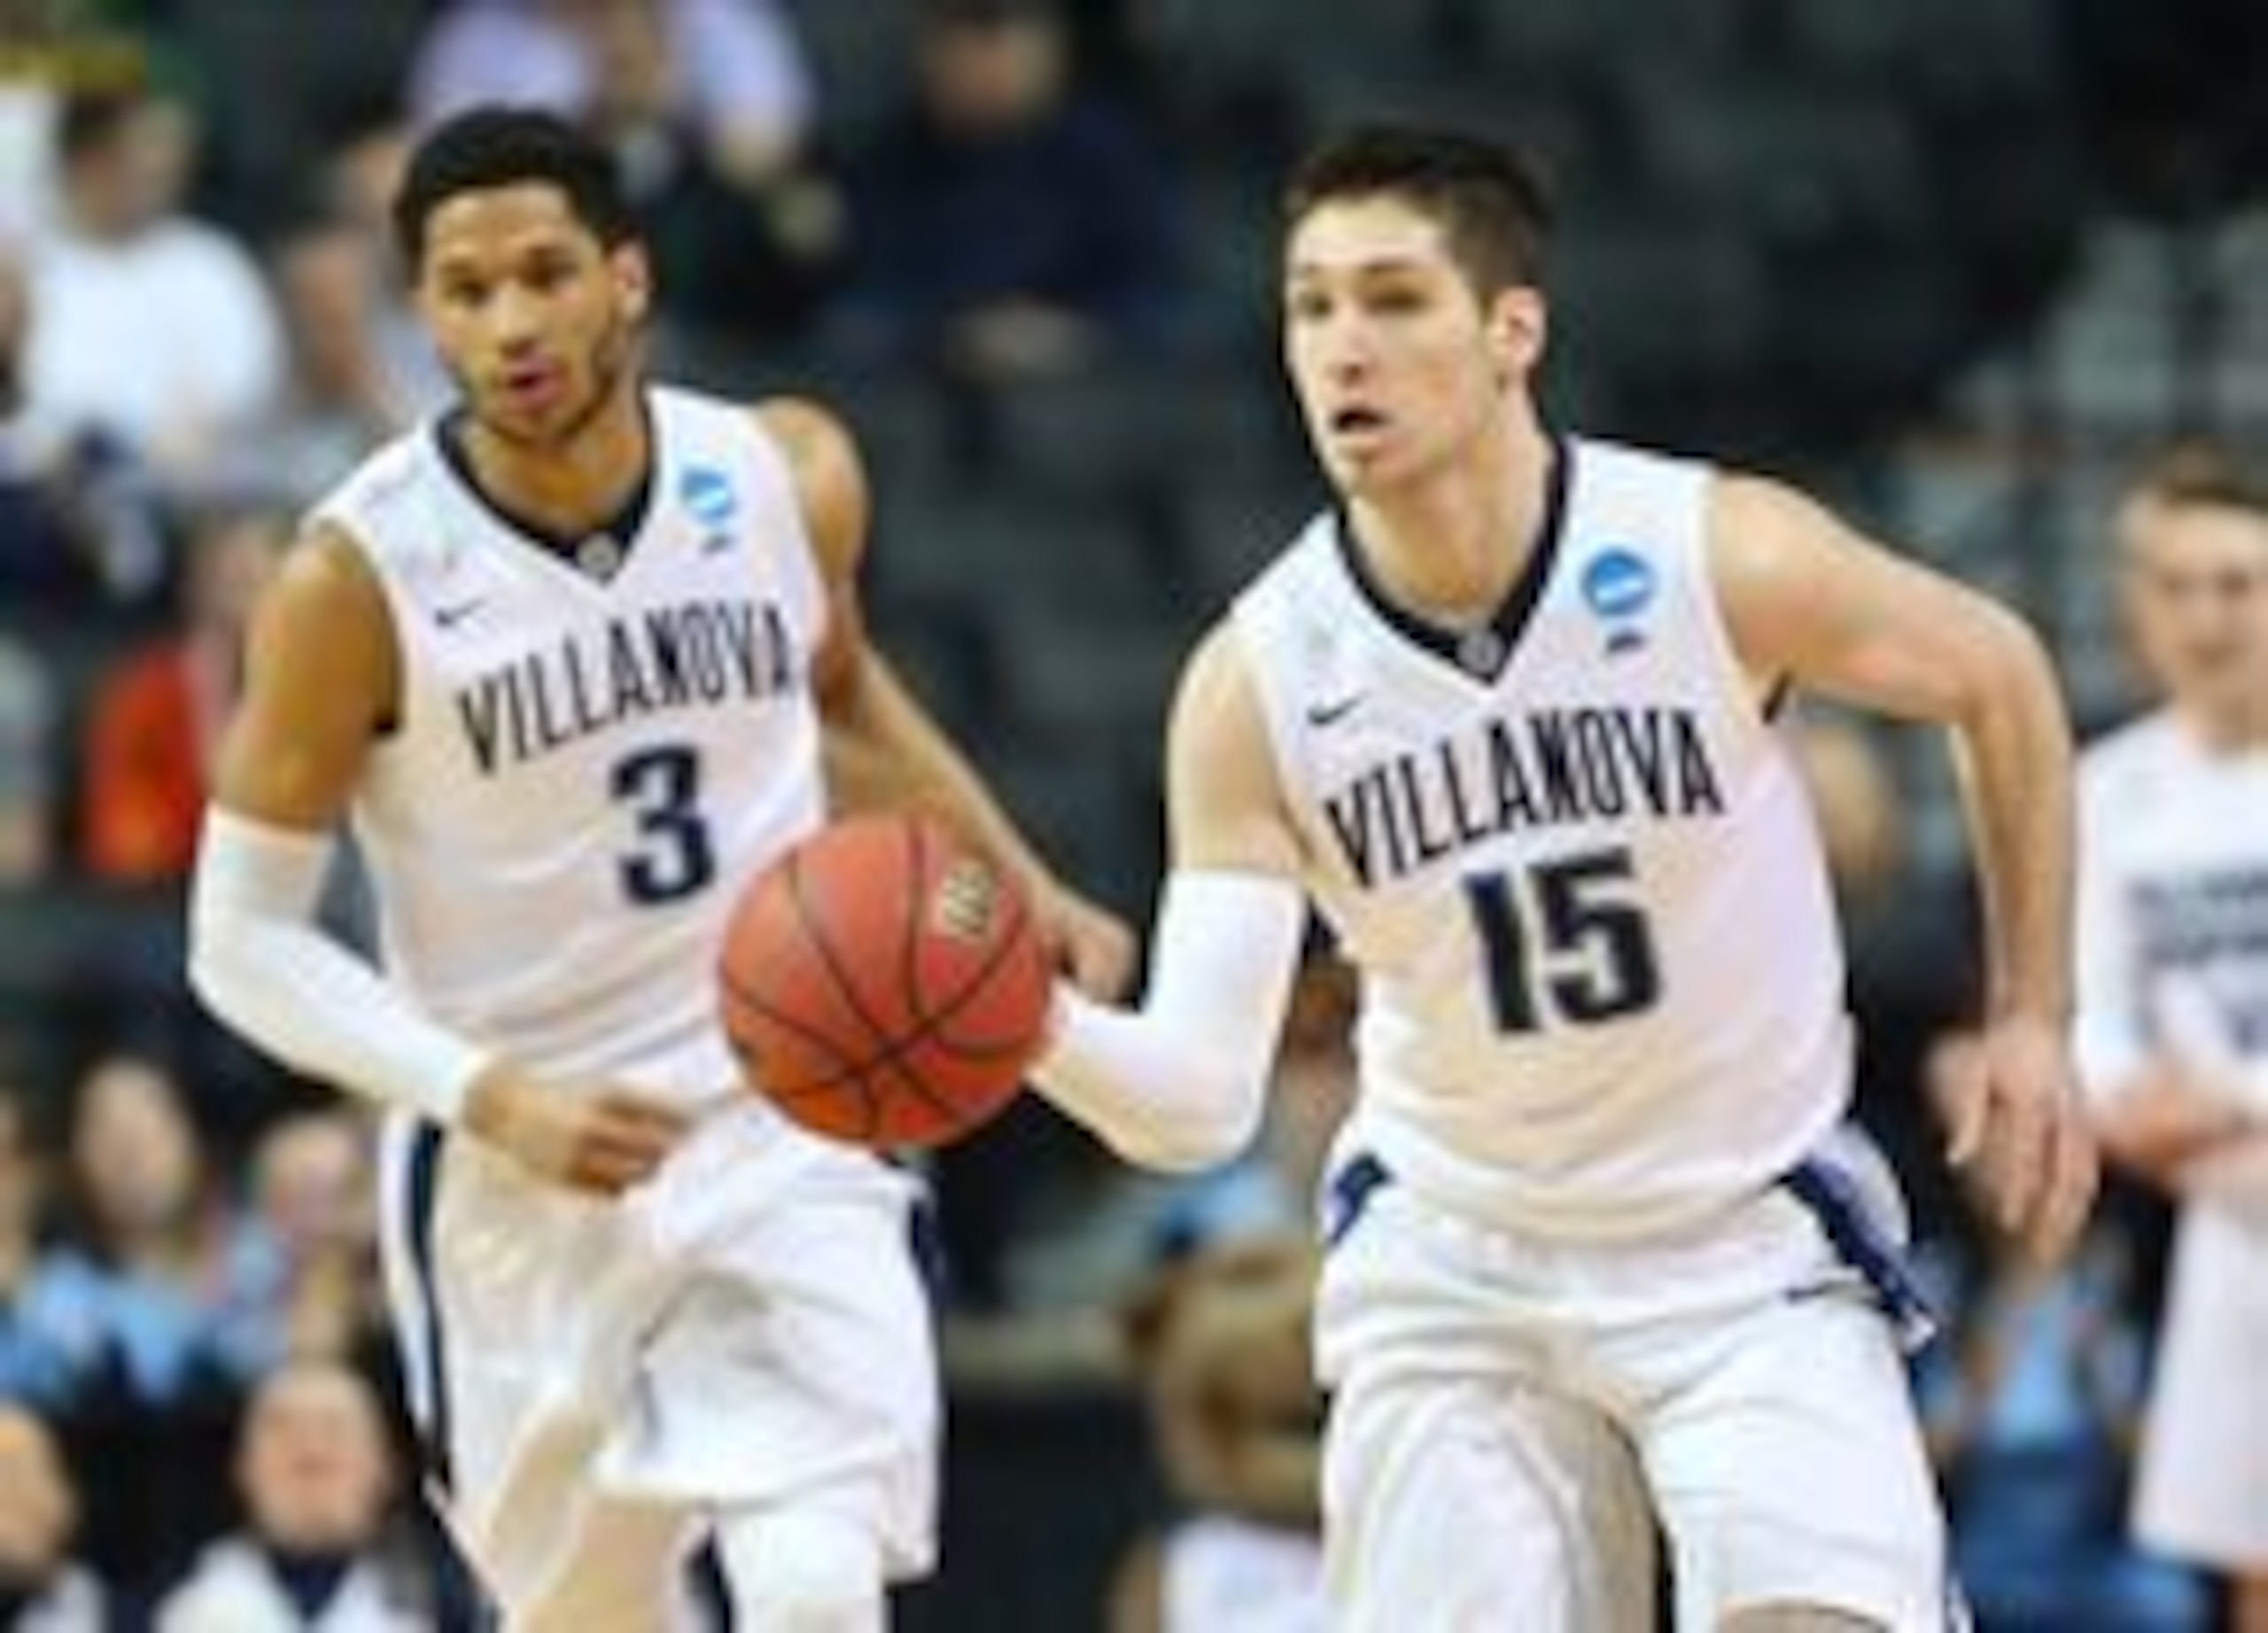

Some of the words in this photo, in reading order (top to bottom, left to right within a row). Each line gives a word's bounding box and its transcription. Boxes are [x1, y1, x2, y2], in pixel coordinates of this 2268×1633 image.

[459, 602, 790, 776] VILLANOVA
[610, 743, 714, 905] 3
[1326, 707, 1724, 887] VILLANOVA
[1464, 847, 1662, 1034] 15
